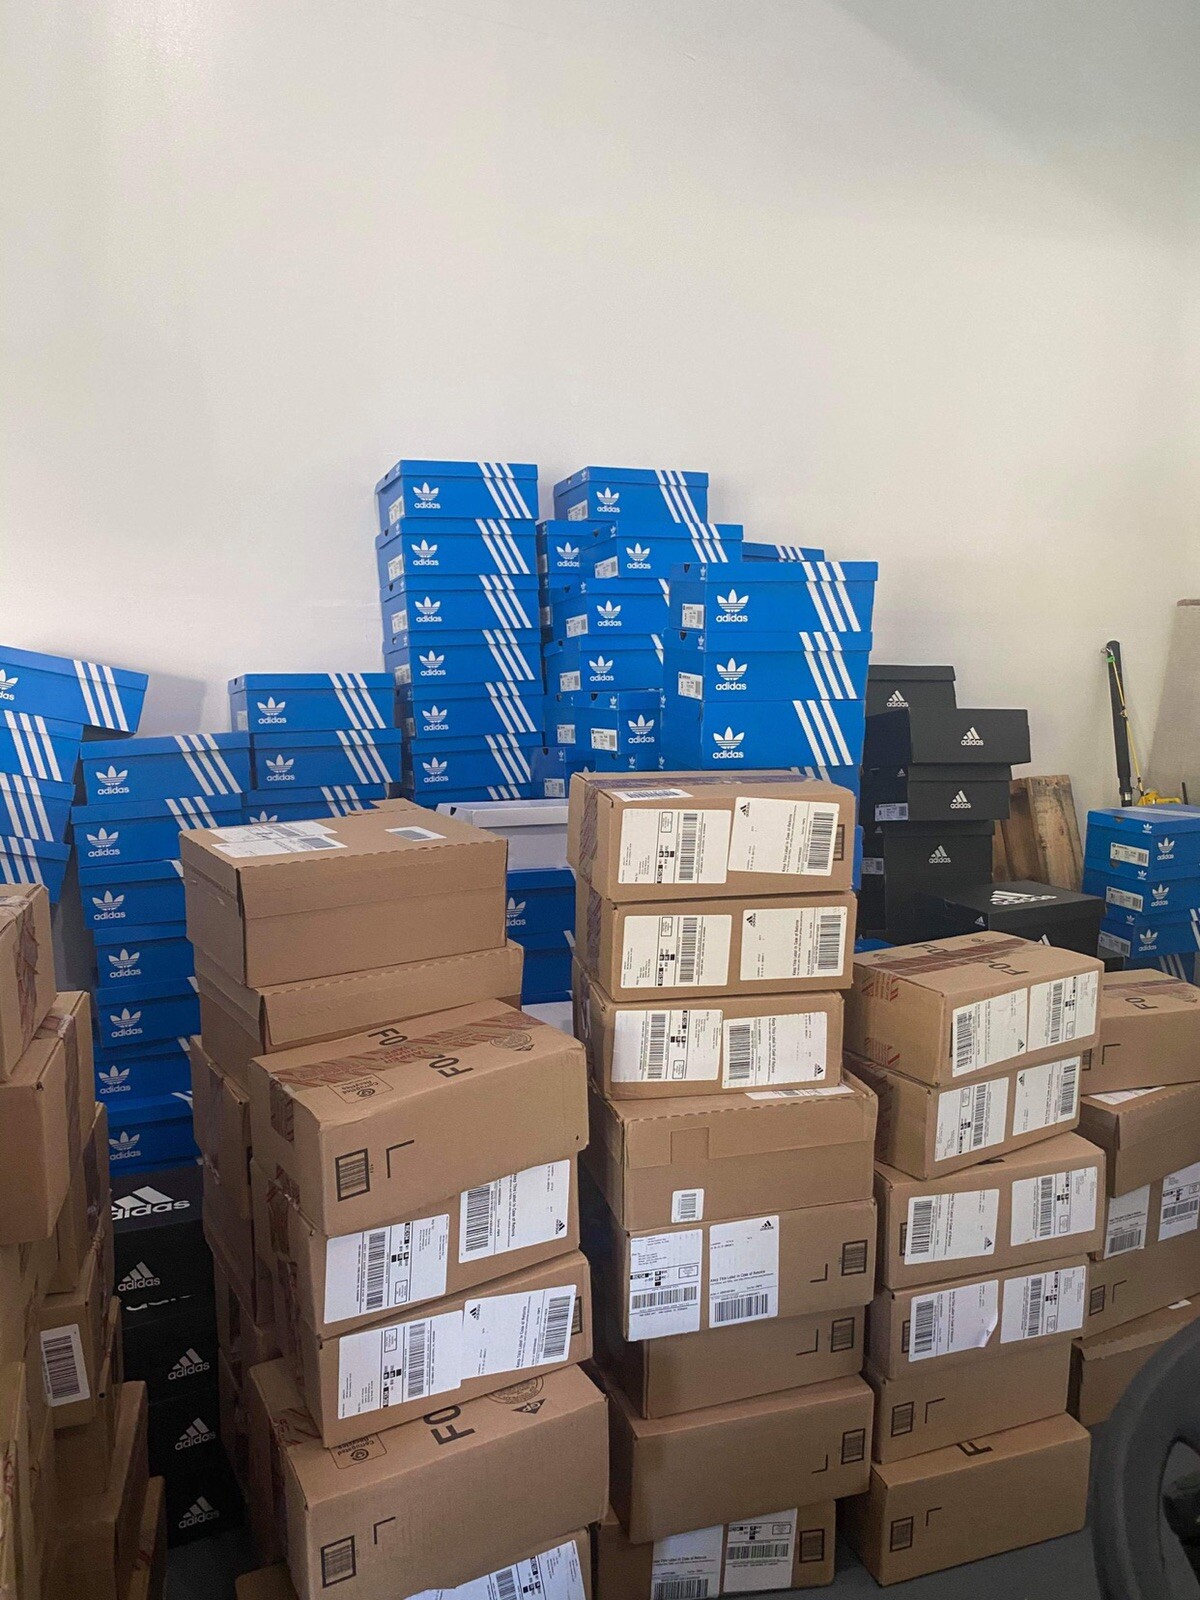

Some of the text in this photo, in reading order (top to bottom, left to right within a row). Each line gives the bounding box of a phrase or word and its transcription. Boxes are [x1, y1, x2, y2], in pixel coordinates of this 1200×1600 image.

[412, 558, 439, 566] adidas
[626, 562, 652, 570] adidas
[416, 615, 443, 623] adidas
[715, 614, 749, 623] adidas
[420, 669, 446, 677] adidas
[589, 674, 615, 682] adidas
[715, 681, 747, 691] adidas
[258, 716, 287, 725] adidas
[423, 723, 449, 731] adidas
[628, 735, 655, 744] adidas
[960, 738, 984, 746] adidas
[712, 751, 744, 760] adidas
[266, 774, 295, 782] adidas
[423, 775, 449, 784] adidas
[97, 786, 130, 796] adidas
[88, 847, 121, 858] adidas
[1156, 853, 1175, 861] adidas
[93, 911, 126, 921] adidas
[506, 918, 527, 927] idas
[1138, 944, 1157, 952] adidas
[109, 968, 142, 978] adidas
[111, 1027, 143, 1038] adidas
[99, 1084, 131, 1095] adidas
[109, 1150, 142, 1161] adidas
[111, 1199, 191, 1221] didas
[117, 1276, 161, 1292] adidas
[167, 1361, 210, 1381] adidas
[174, 1430, 217, 1451] adidas
[178, 1509, 220, 1529] adidas
